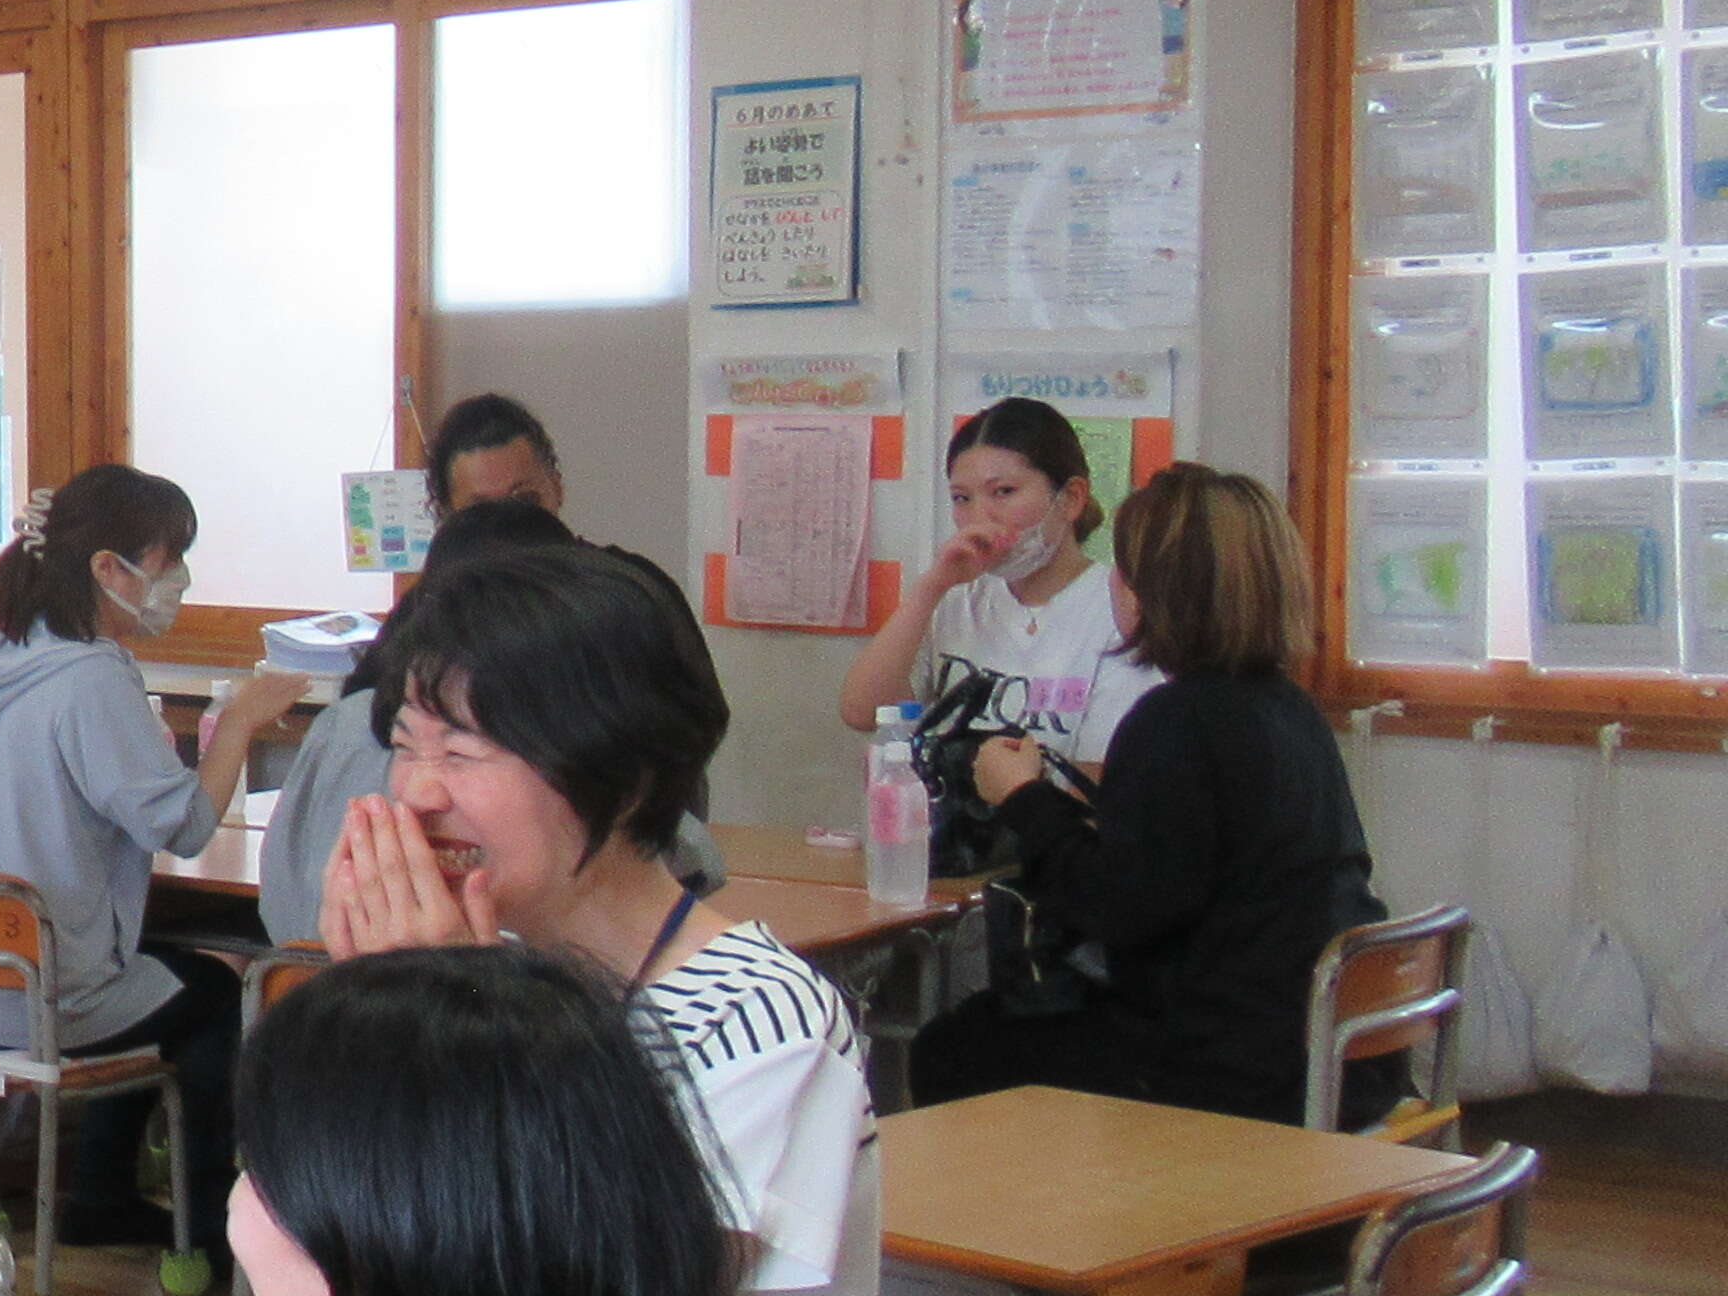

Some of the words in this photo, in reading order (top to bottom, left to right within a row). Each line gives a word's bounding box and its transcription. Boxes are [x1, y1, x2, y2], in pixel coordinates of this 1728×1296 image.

[736, 101, 835, 124] 6月のめあて
